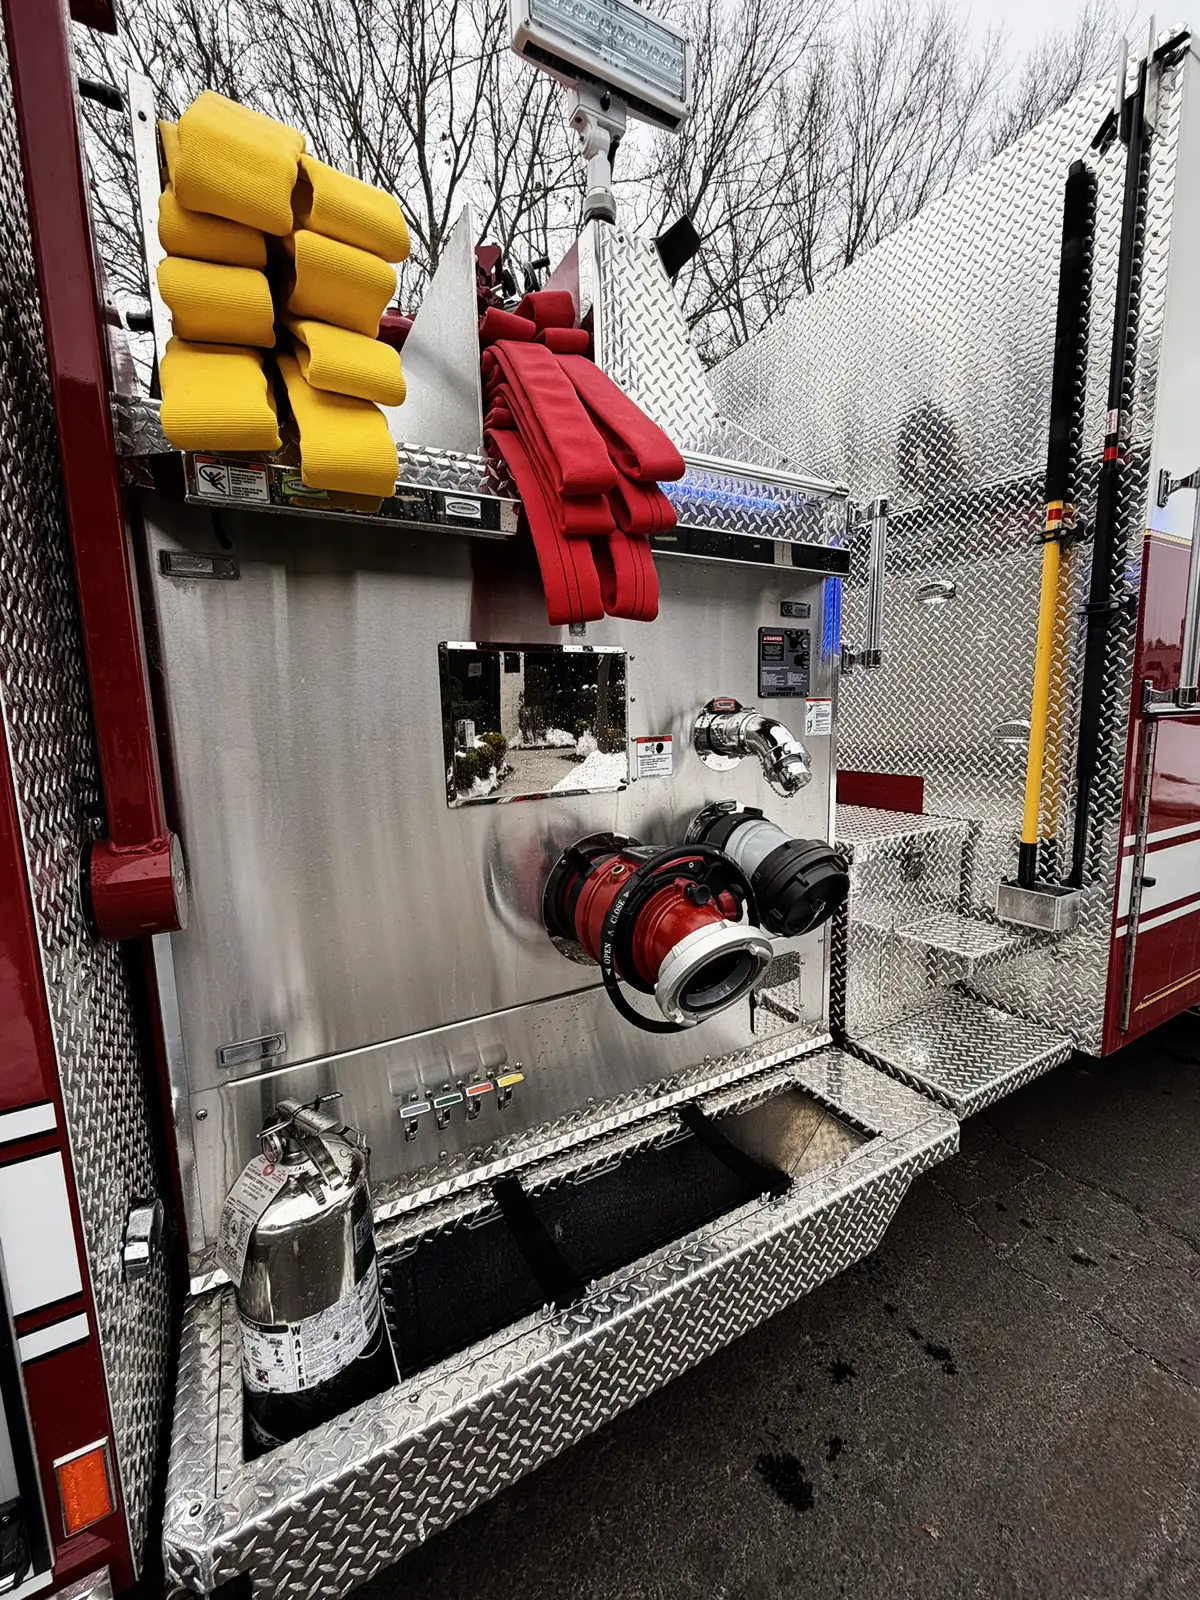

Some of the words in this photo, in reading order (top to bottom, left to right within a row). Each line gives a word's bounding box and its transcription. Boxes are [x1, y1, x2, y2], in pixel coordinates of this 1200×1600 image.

[603, 942, 612, 965] OPEN
[610, 899, 626, 924] CLOSE
[291, 1325, 305, 1388] WATER
